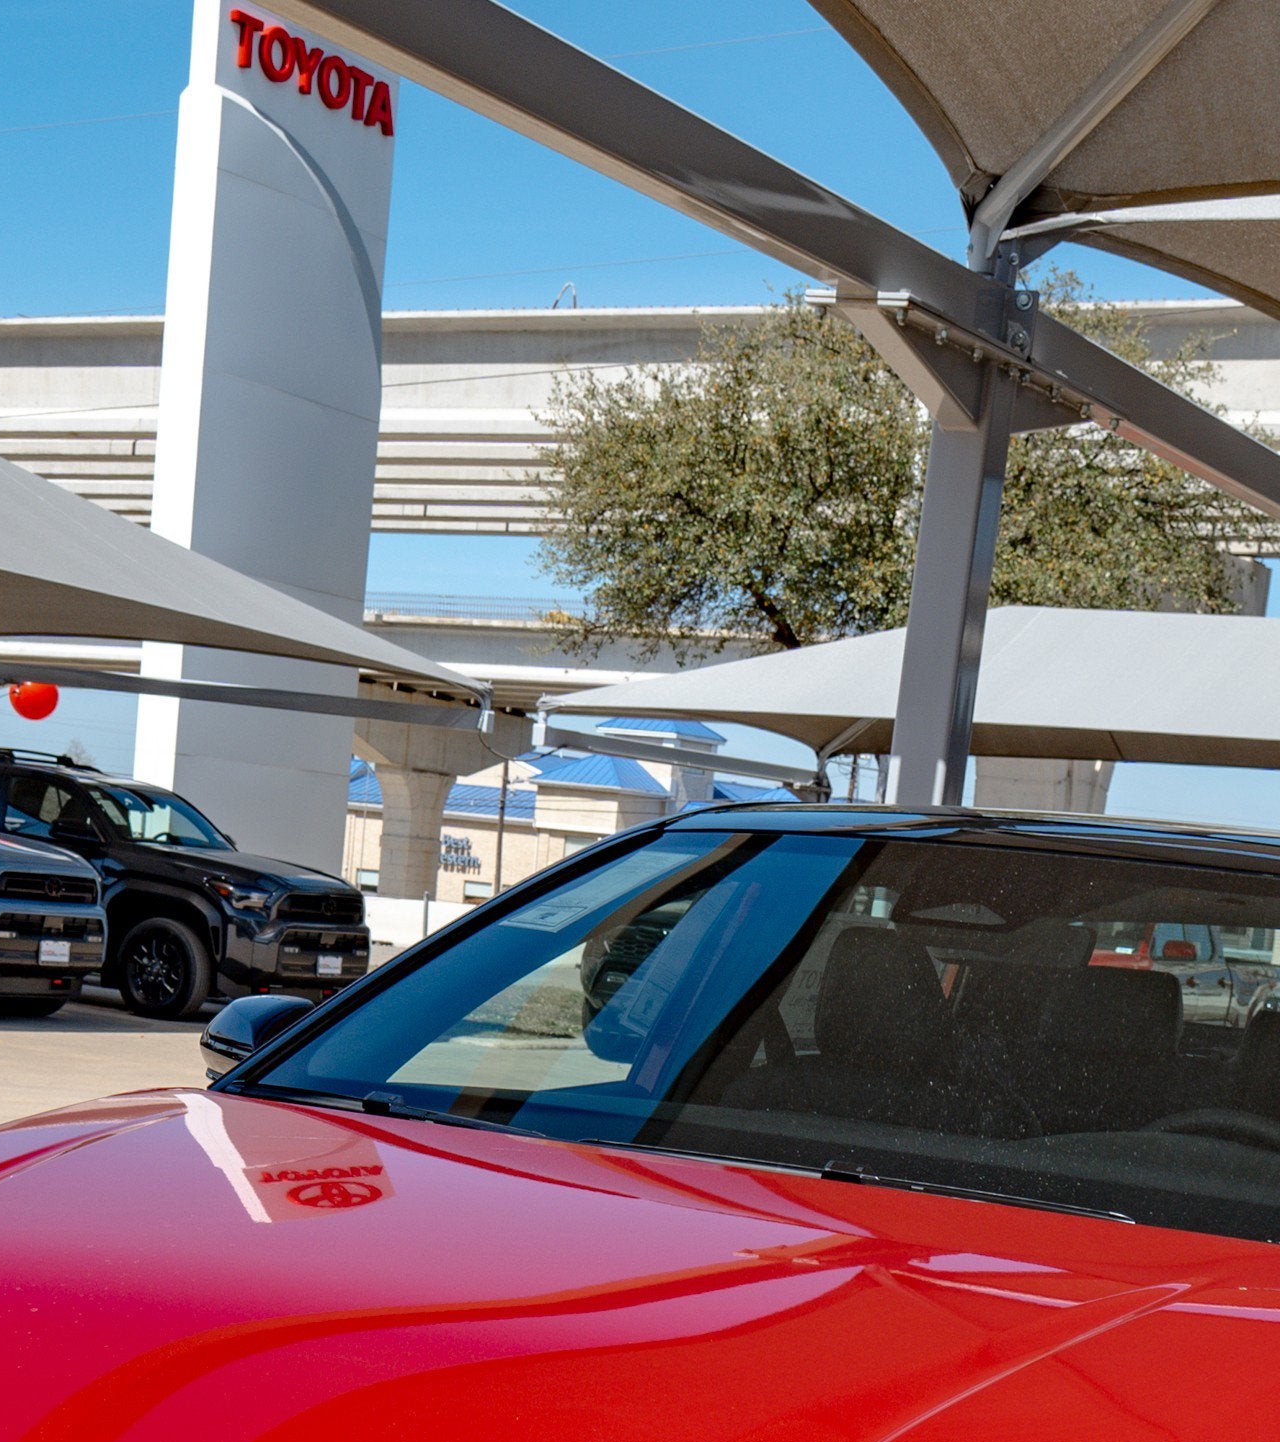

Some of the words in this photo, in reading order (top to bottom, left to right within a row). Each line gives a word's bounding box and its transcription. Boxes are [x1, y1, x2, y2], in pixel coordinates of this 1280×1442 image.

[230, 8, 394, 137] TOYOTA
[443, 834, 470, 849] Best
[440, 852, 480, 868] estern
